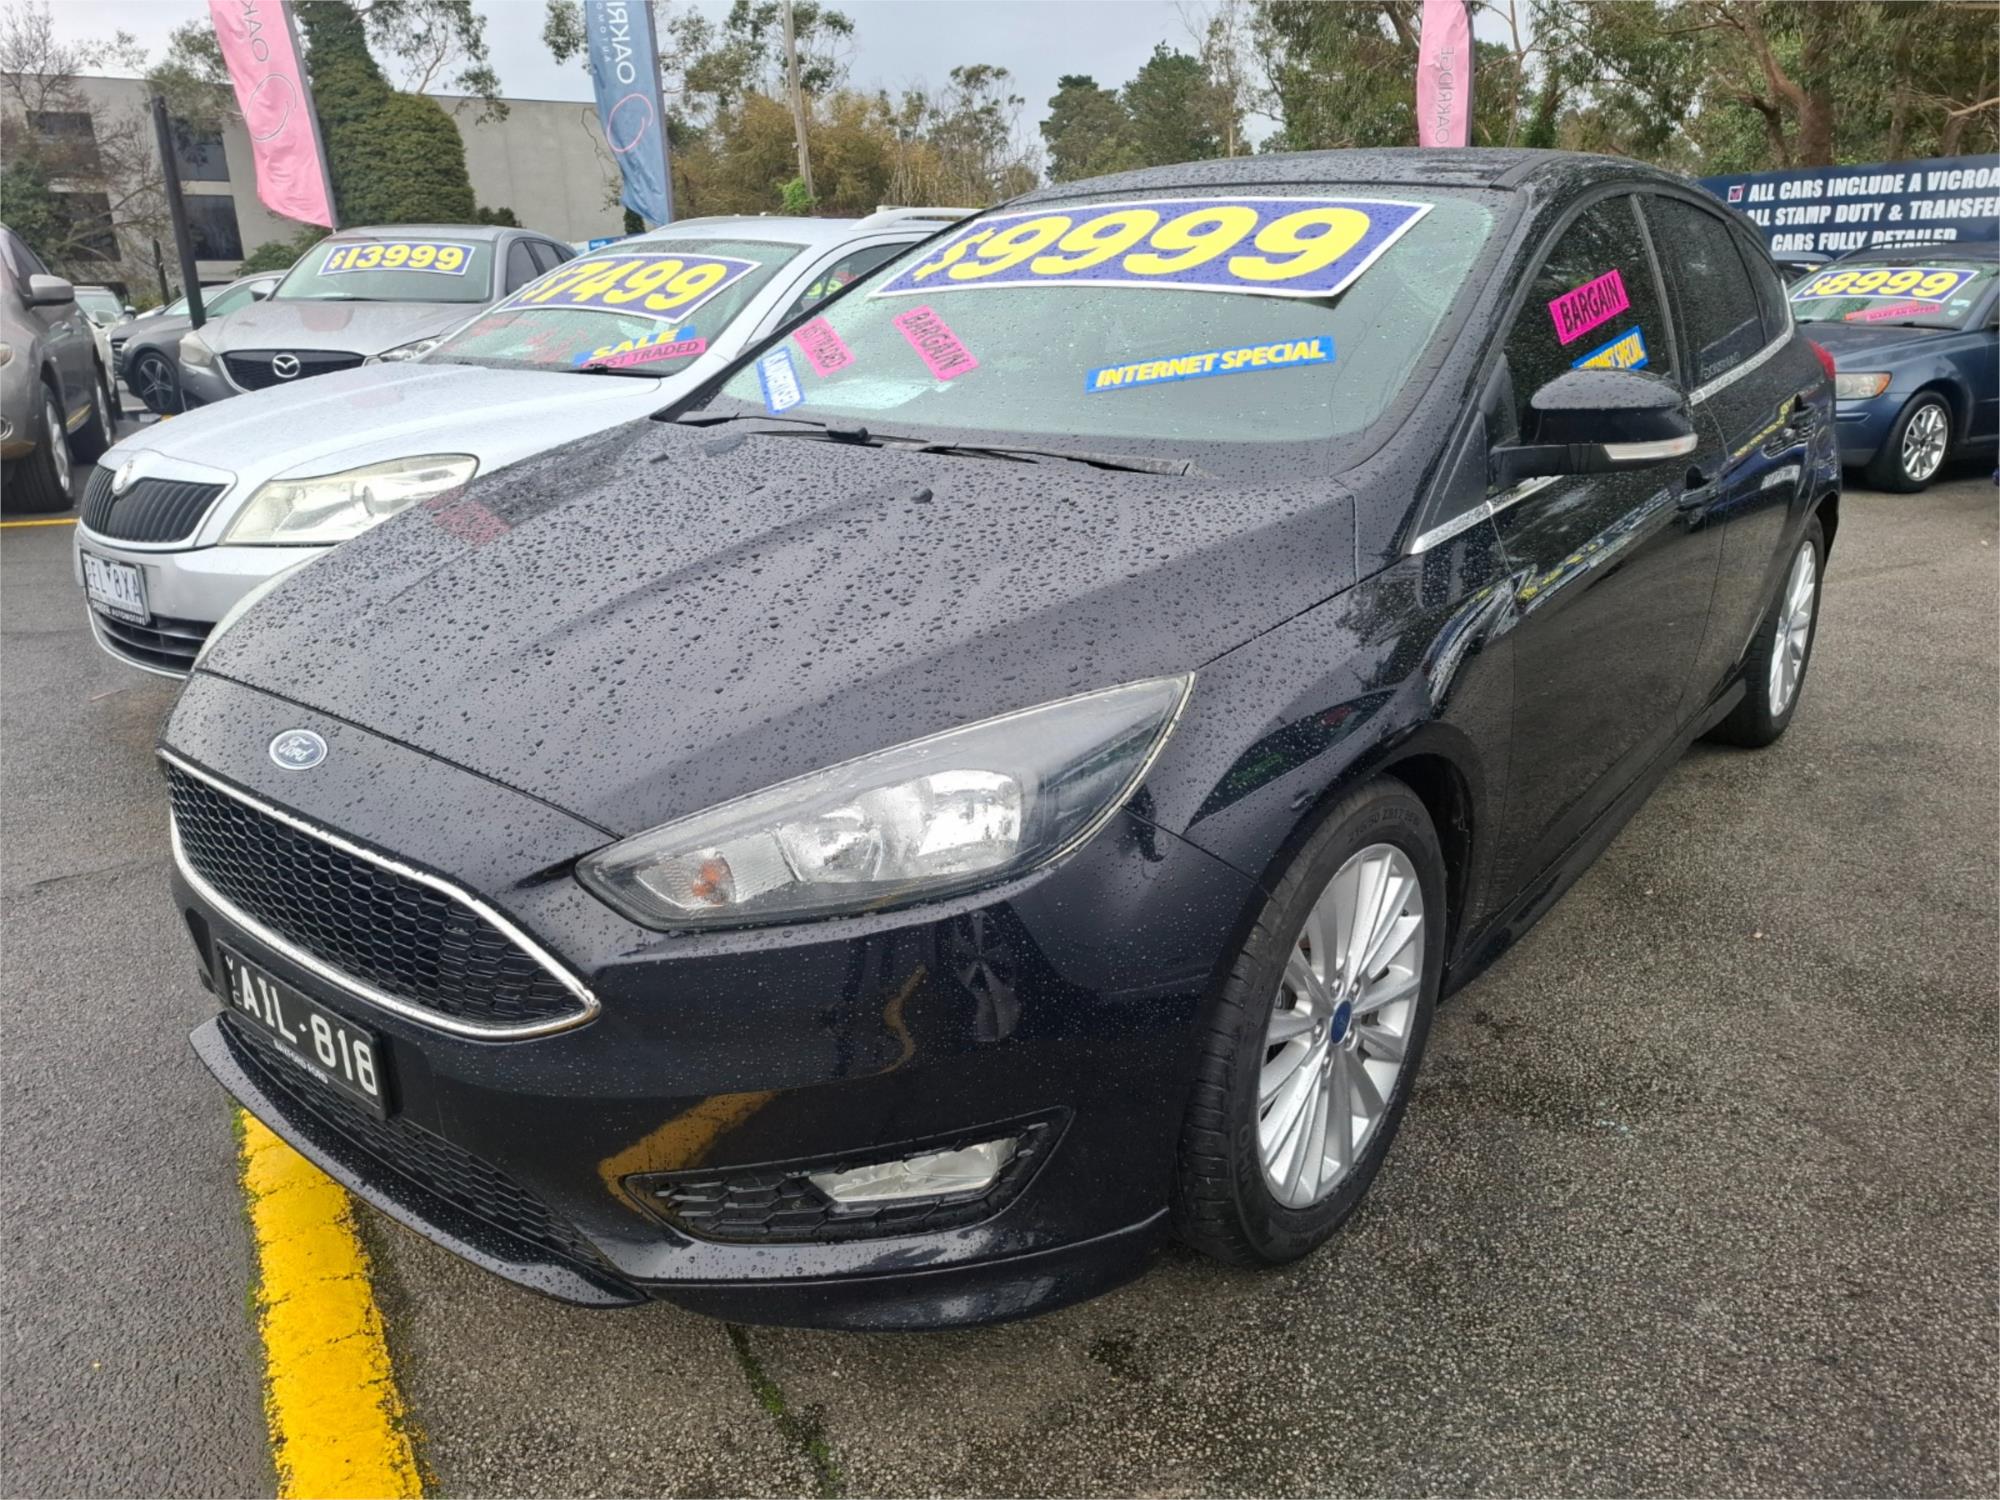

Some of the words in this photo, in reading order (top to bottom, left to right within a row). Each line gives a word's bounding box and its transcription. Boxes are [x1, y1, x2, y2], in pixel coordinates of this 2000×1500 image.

[1748, 183, 1775, 202] ALL
[1779, 179, 1824, 200] CARS
[1826, 173, 1905, 197] INCLUDE
[1907, 172, 1922, 193] A
[1775, 205, 1832, 226] STAMP
[1834, 203, 1885, 224] DUTY
[1888, 204, 1903, 221] &
[913, 206, 1371, 281] $9999
[1771, 232, 1815, 251] CARS
[1818, 231, 1868, 251] FULLY
[329, 244, 465, 271] $13999
[520, 259, 727, 310] $7499
[1803, 270, 1959, 297] $8999
[1559, 275, 1622, 334] BARGAIN
[590, 328, 679, 361] SALE
[632, 341, 699, 361] TRADED
[902, 311, 970, 371] BARGAIN
[1096, 352, 1219, 388] INTERNET
[1219, 339, 1326, 369] SPECIAL
